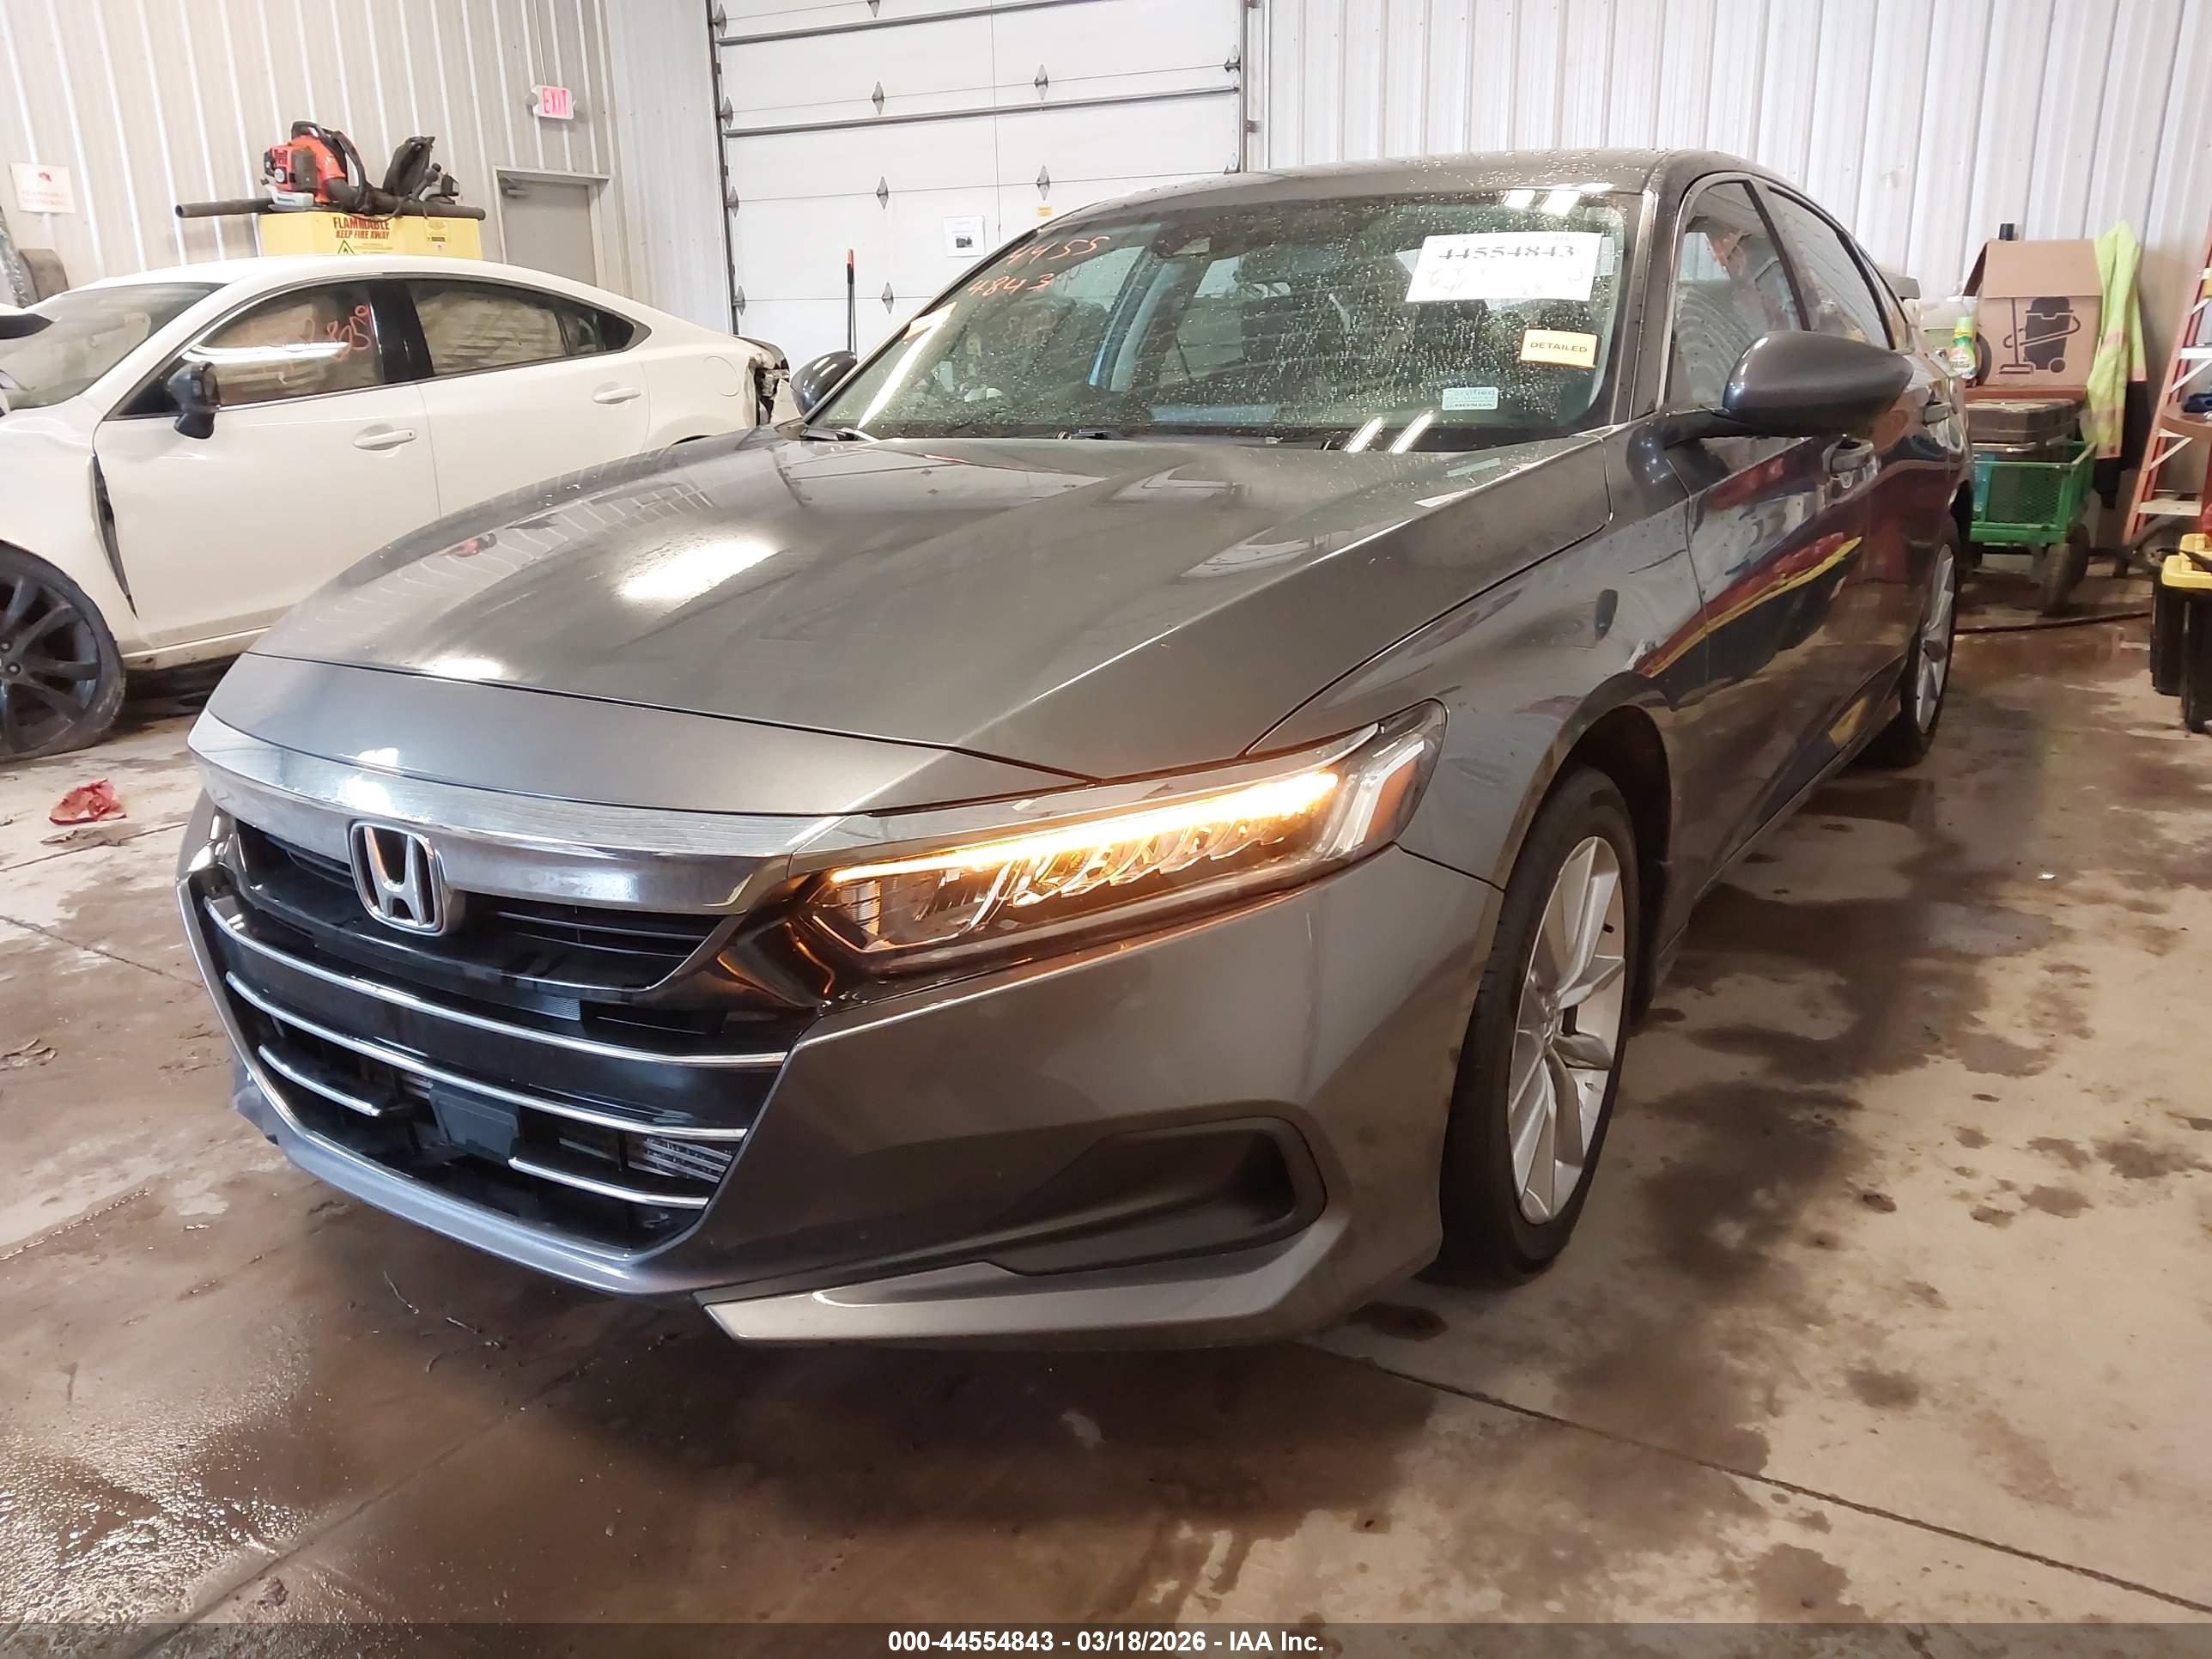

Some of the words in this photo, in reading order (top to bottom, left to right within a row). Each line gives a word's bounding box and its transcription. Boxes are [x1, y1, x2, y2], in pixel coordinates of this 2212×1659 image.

[542, 87, 568, 116] EXIT
[336, 230, 353, 239] KEEP
[354, 230, 368, 239] FIRE
[370, 231, 390, 240] AWAY
[1006, 236, 1111, 265] 4455
[1438, 246, 1575, 260] 44554843
[967, 273, 1055, 296] 4843
[1530, 342, 1588, 353] DETAILED
